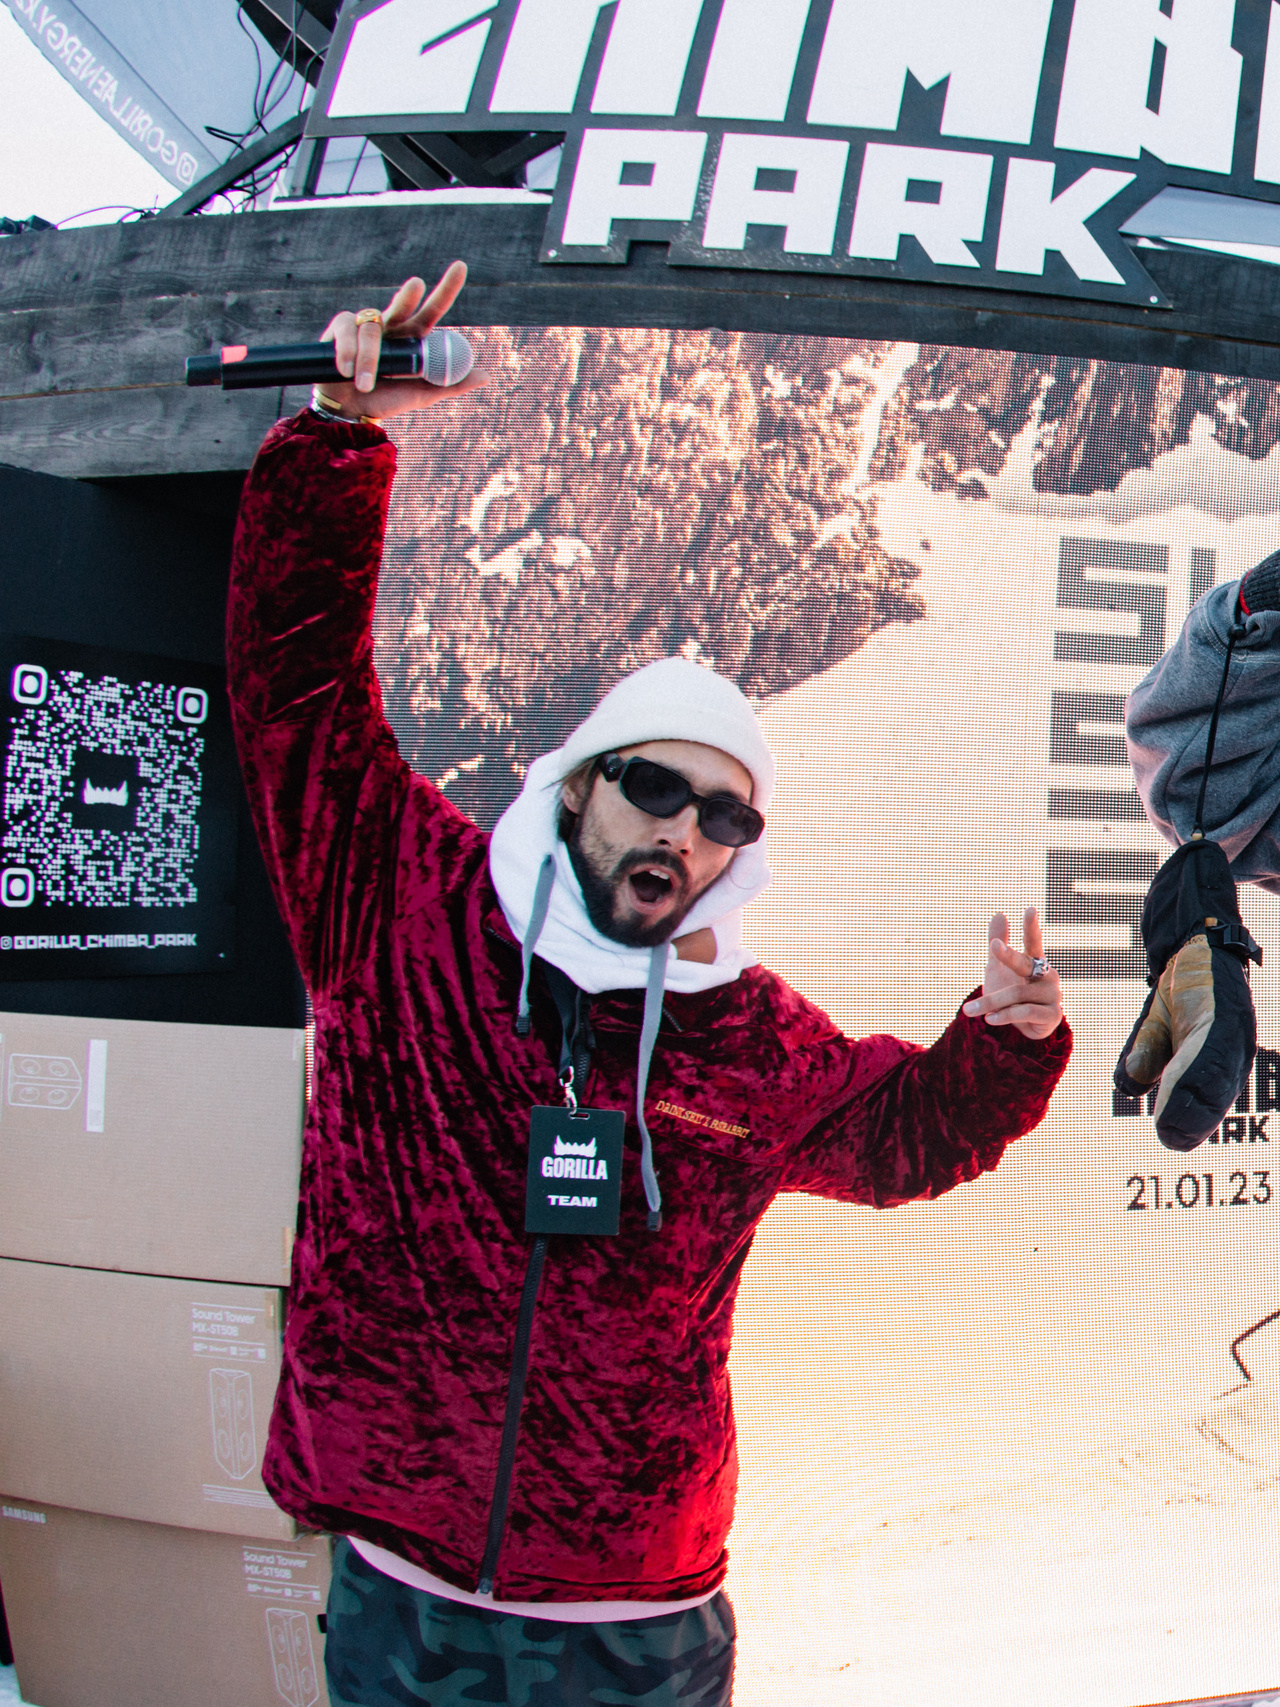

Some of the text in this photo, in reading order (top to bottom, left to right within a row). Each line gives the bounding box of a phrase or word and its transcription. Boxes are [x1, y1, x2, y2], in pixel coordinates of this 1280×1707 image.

[561, 127, 1137, 286] PARK
[541, 1156, 608, 1180] GORILLA
[1126, 1171, 1272, 1211] 21.01.23
[546, 1194, 598, 1208] TEAM
[191, 1307, 256, 1325] Sound Tower
[2, 1505, 46, 1524] SAMSUNG
[243, 1551, 307, 1568] Sound Tower
